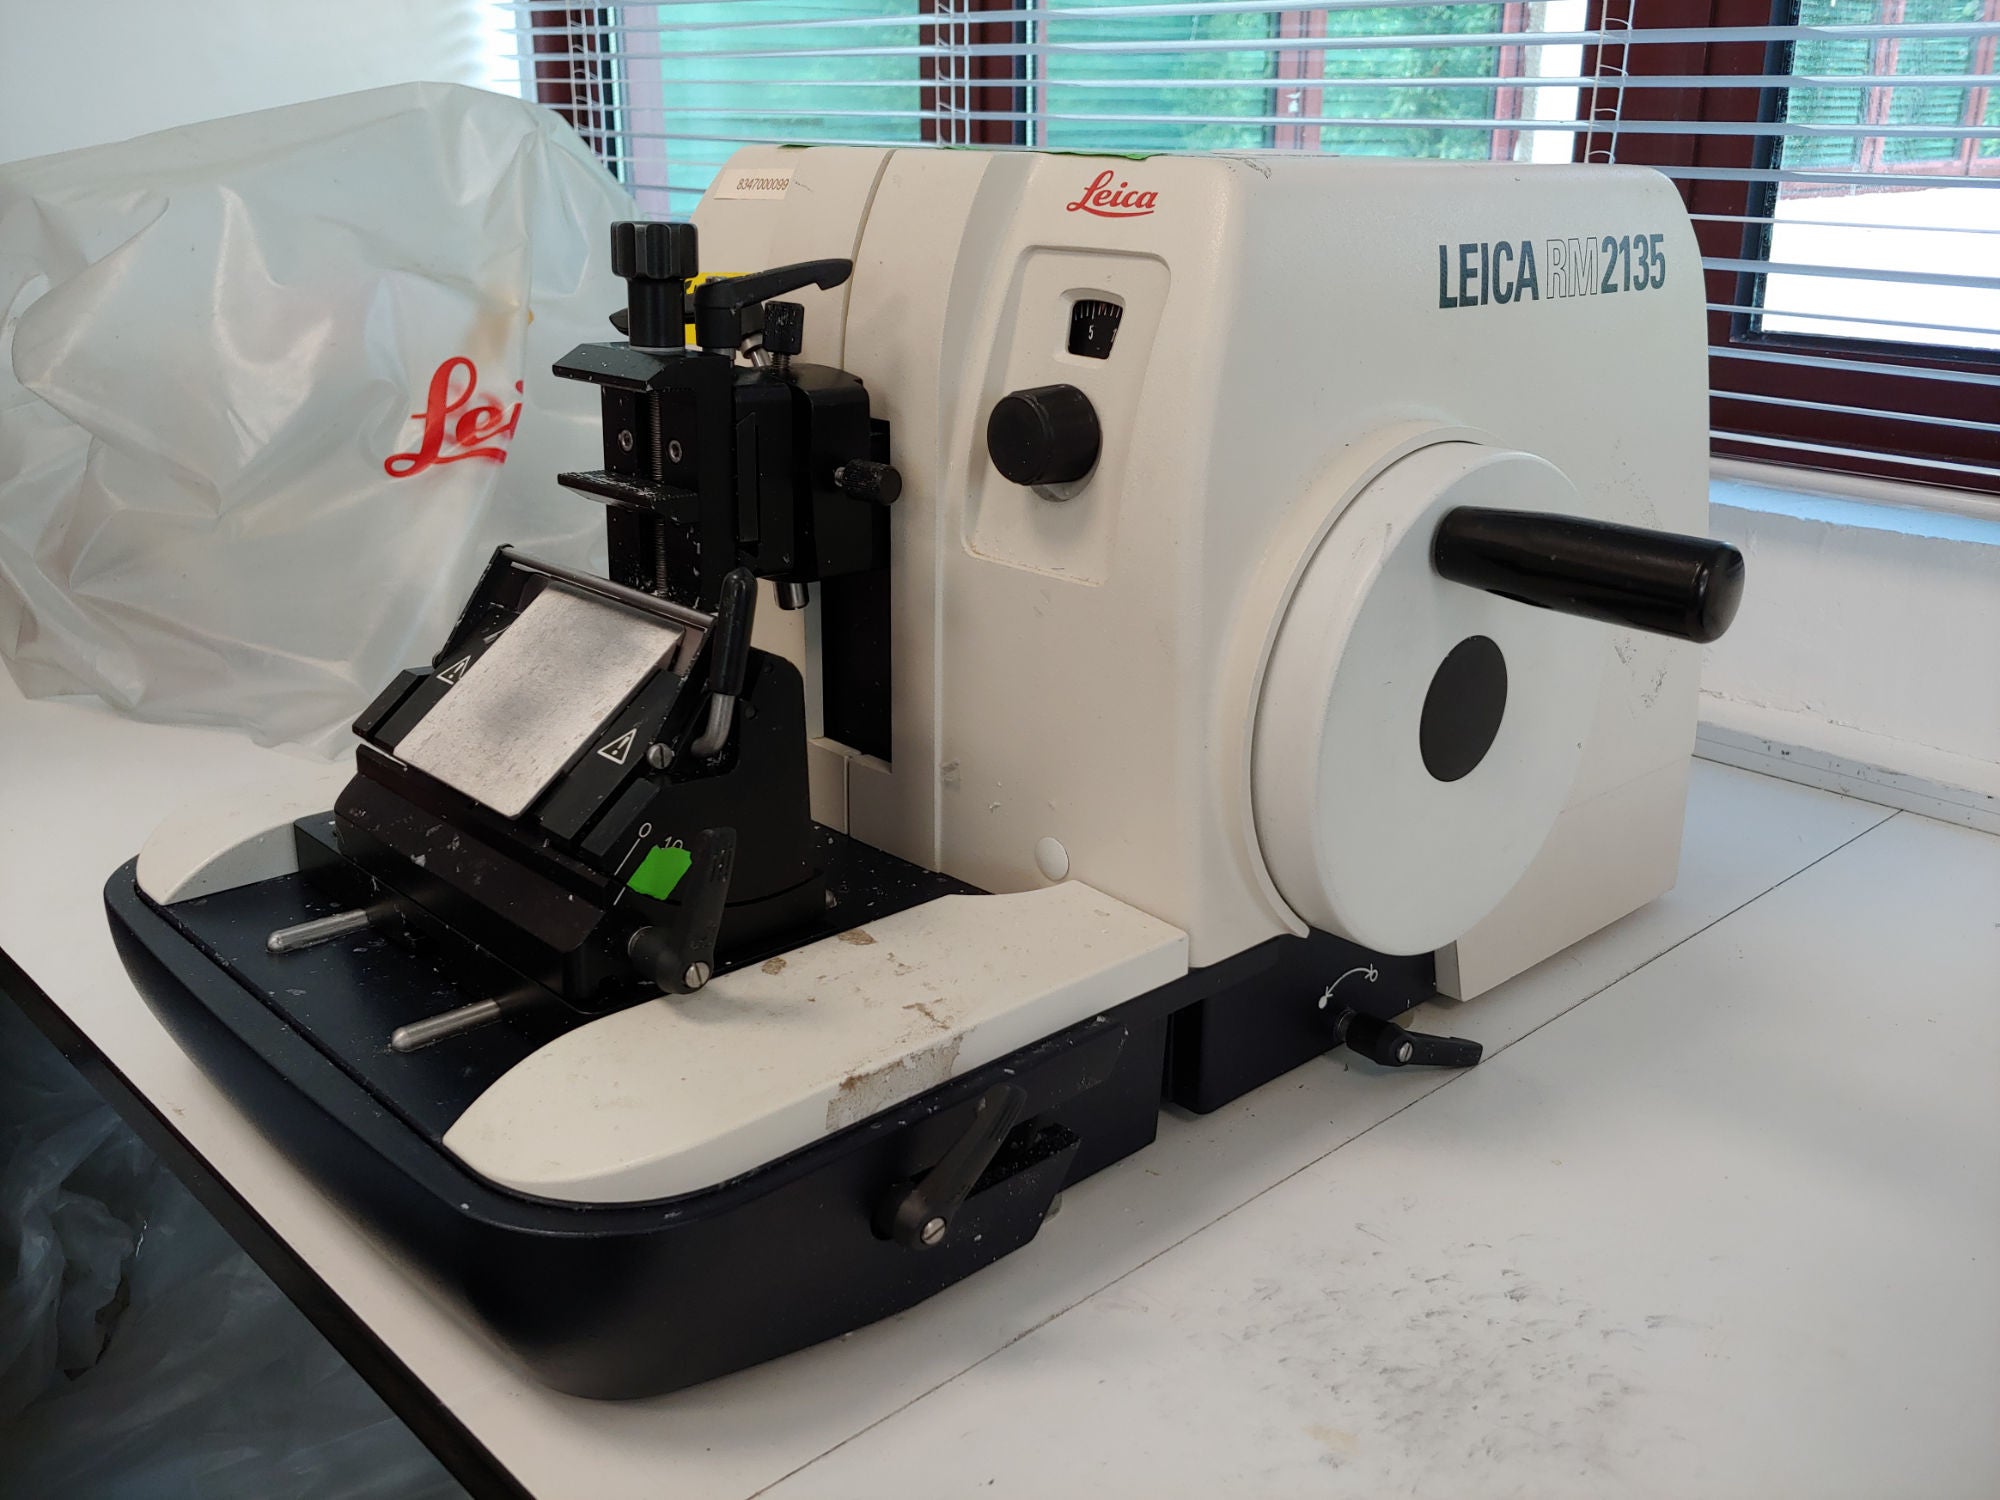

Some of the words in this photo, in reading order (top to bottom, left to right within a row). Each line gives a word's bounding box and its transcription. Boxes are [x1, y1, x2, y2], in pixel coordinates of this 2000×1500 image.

[736, 178, 790, 191] 8347000099
[1066, 169, 1159, 218] Leica
[1438, 240, 1540, 309] LEICA
[1088, 324, 1095, 341] 5
[384, 356, 524, 478] Lei
